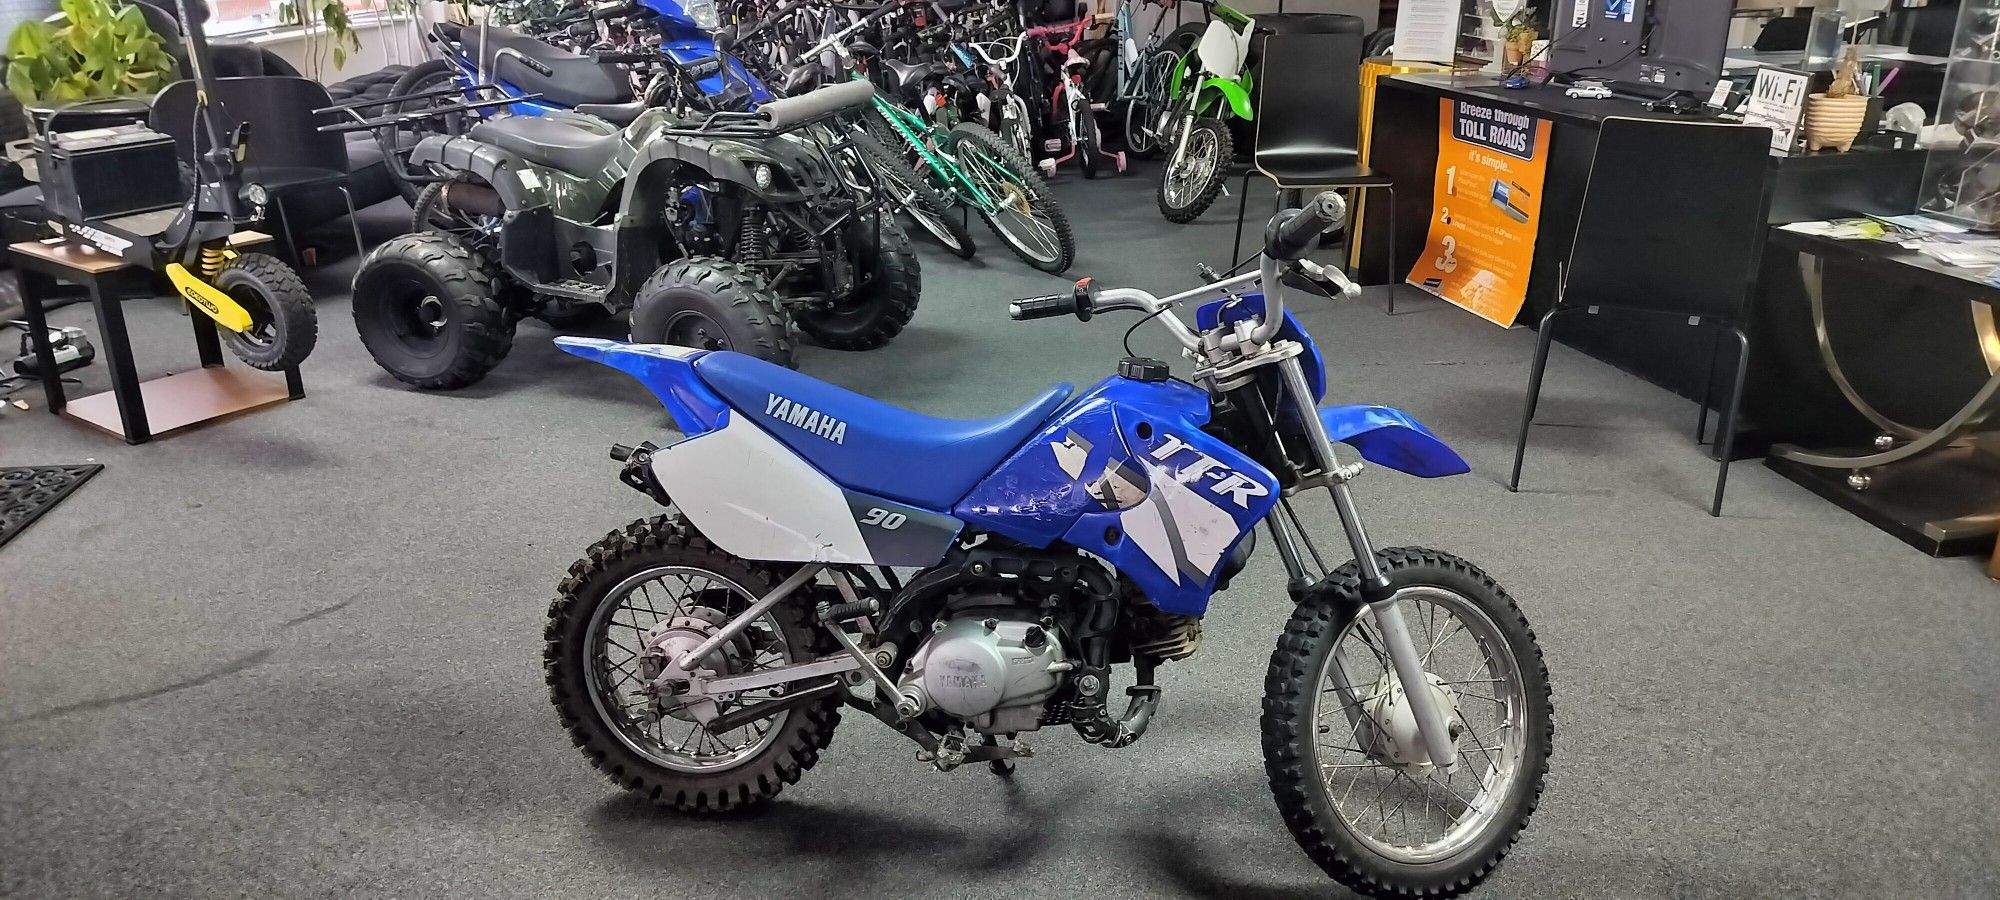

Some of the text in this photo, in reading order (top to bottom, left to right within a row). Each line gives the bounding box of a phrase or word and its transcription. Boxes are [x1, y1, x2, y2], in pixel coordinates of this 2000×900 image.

[1759, 73, 1803, 106] Wi-Fi
[1460, 101, 1530, 131] Breeze through
[1459, 118, 1527, 152] TOLL ROADS
[1468, 149, 1481, 161] it's
[1446, 165, 1456, 195] 1
[1435, 235, 1457, 274] 3
[765, 392, 847, 445] YAMAHA
[1150, 433, 1269, 509] TT-R
[859, 507, 907, 530] 90
[939, 674, 987, 688] YAMAHA
